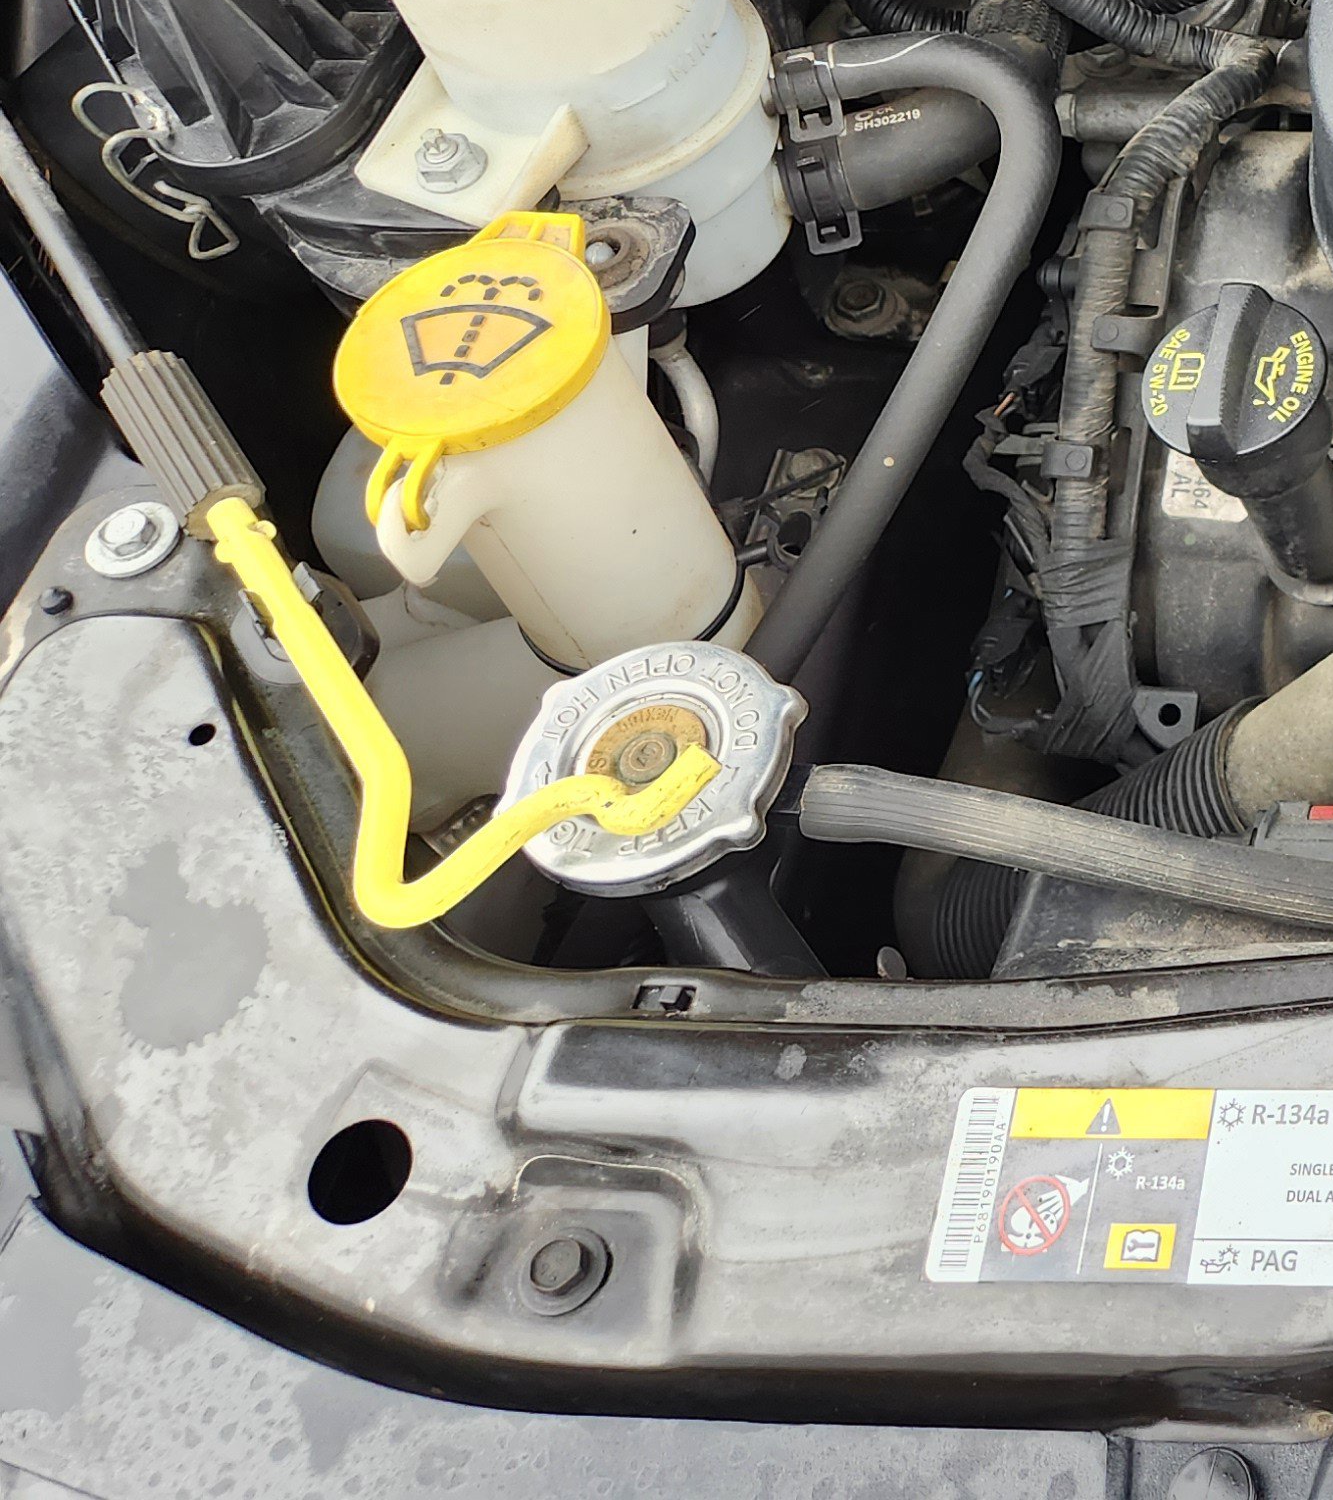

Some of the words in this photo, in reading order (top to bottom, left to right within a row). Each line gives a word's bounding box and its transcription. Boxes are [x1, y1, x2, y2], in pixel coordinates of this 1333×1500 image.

[1158, 328, 1191, 361] SAE
[1289, 330, 1315, 395] ENGINE
[1148, 363, 1168, 416] 5W-20
[1268, 396, 1301, 423] OIL
[606, 653, 696, 695] OPEN
[700, 662, 754, 710] NOT
[542, 686, 600, 743] HOT
[732, 708, 761, 752] DO
[1251, 1104, 1329, 1125] R-134a
[1136, 1176, 1186, 1190] R-134a
[1286, 1190, 1322, 1203] DUAL
[1250, 1250, 1298, 1272] PAG
